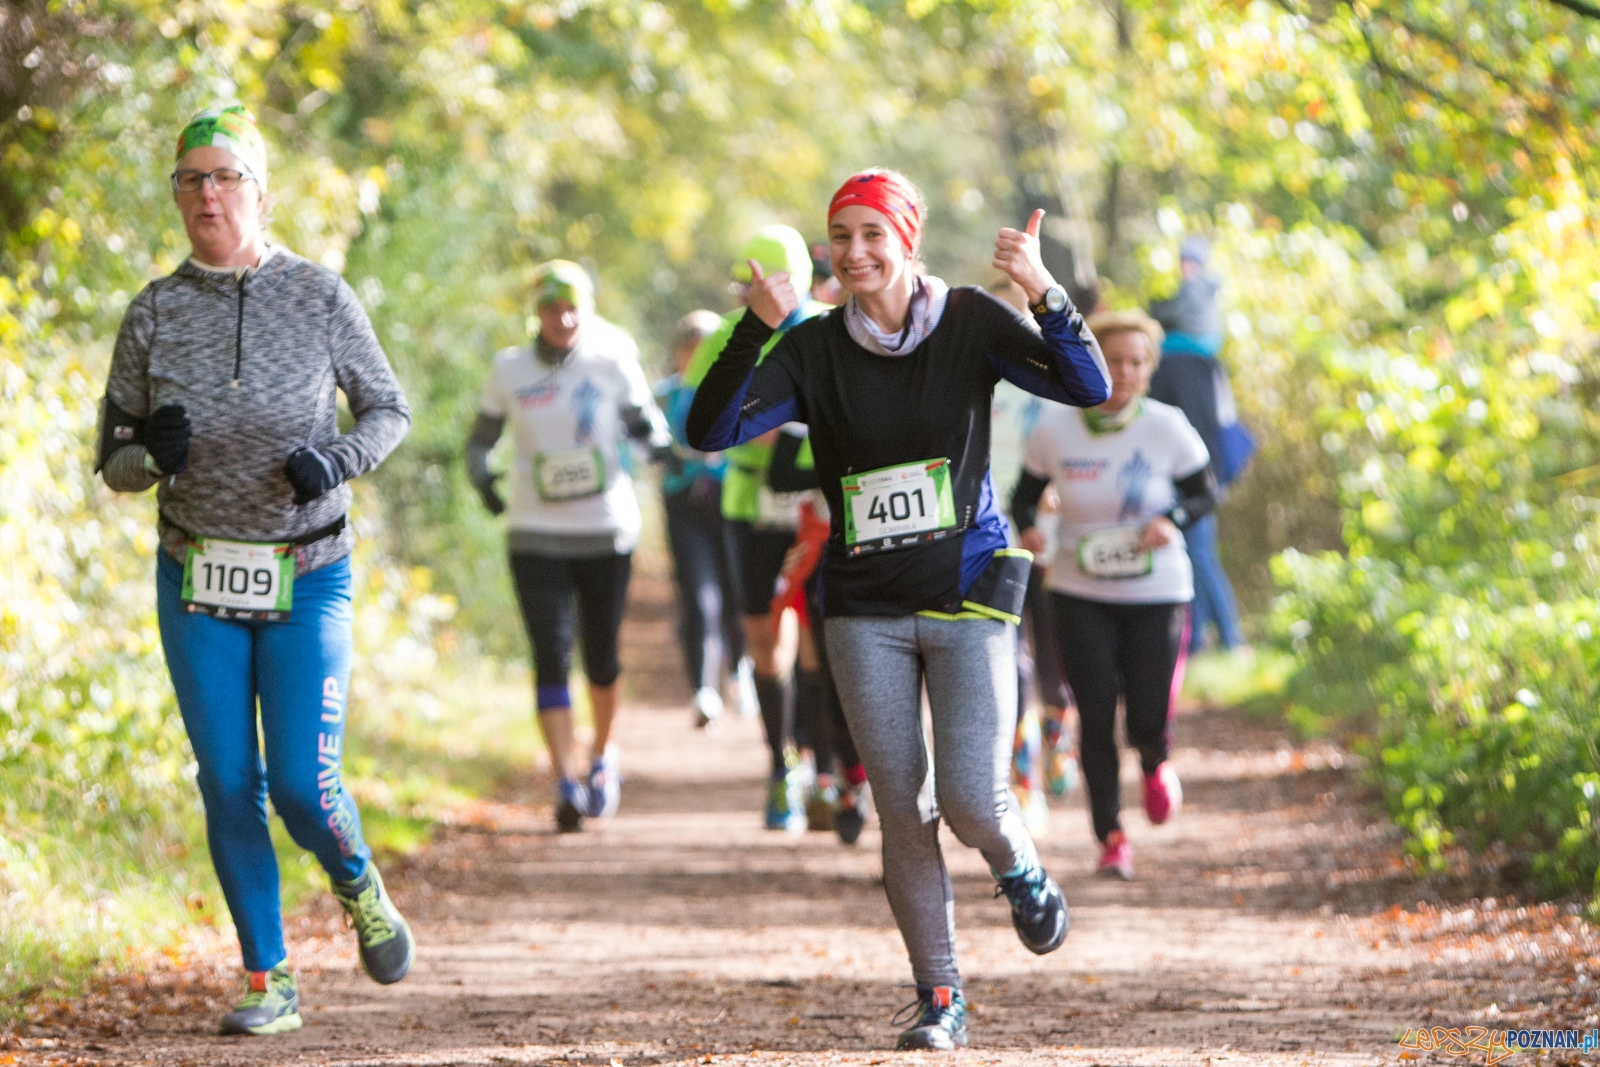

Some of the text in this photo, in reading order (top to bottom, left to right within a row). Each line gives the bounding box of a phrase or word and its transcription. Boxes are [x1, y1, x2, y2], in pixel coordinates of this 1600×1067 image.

[867, 488, 925, 524] 401
[879, 523, 917, 536] DOMINIKA
[202, 562, 272, 596] 1109
[320, 676, 344, 723] UP
[317, 732, 343, 811] GIVE
